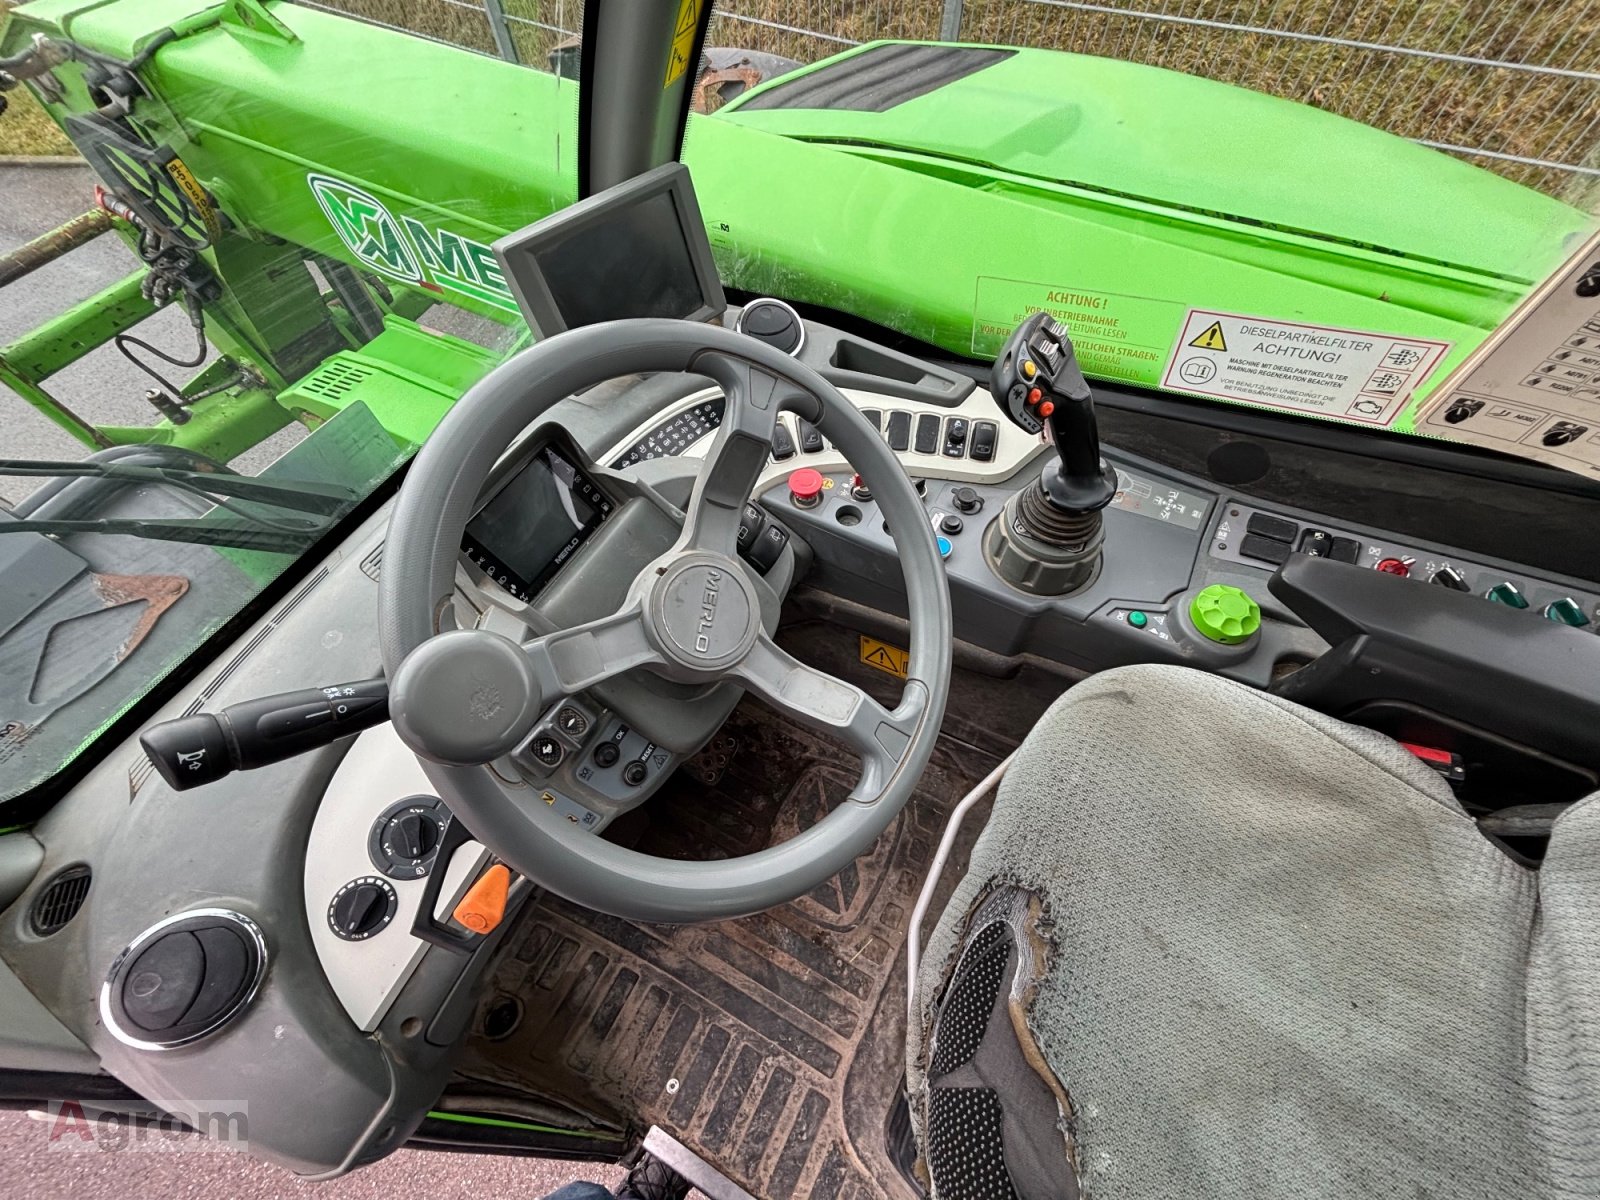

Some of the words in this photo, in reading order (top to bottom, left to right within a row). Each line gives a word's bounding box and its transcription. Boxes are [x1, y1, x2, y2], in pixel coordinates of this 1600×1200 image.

[1046, 290, 1101, 309] ACHTUNG
[980, 324, 995, 335] VOR
[996, 327, 1012, 337] DER
[1102, 328, 1128, 340] LESEN
[1240, 325, 1373, 352] DIESELPARTIKELFILTER
[1252, 341, 1342, 365] ACHTUNG!
[1226, 364, 1258, 375] WARNUNG
[1258, 369, 1307, 383] REGENERATION
[1307, 377, 1344, 389] BEACHTEN
[1229, 357, 1261, 368] MASCHINE
[1261, 362, 1273, 370] MIT
[1272, 364, 1349, 382] DIESELPARTIKELFILTER
[1223, 384, 1300, 402] BETRIEBSANWEISUNG
[1235, 380, 1279, 392] BENUTZUNG
[1279, 388, 1323, 400] UNBEDINGT
[554, 536, 579, 565] MERLO
[694, 570, 722, 654] MERLO
[615, 728, 625, 741] OK
[641, 743, 655, 762] RESET
